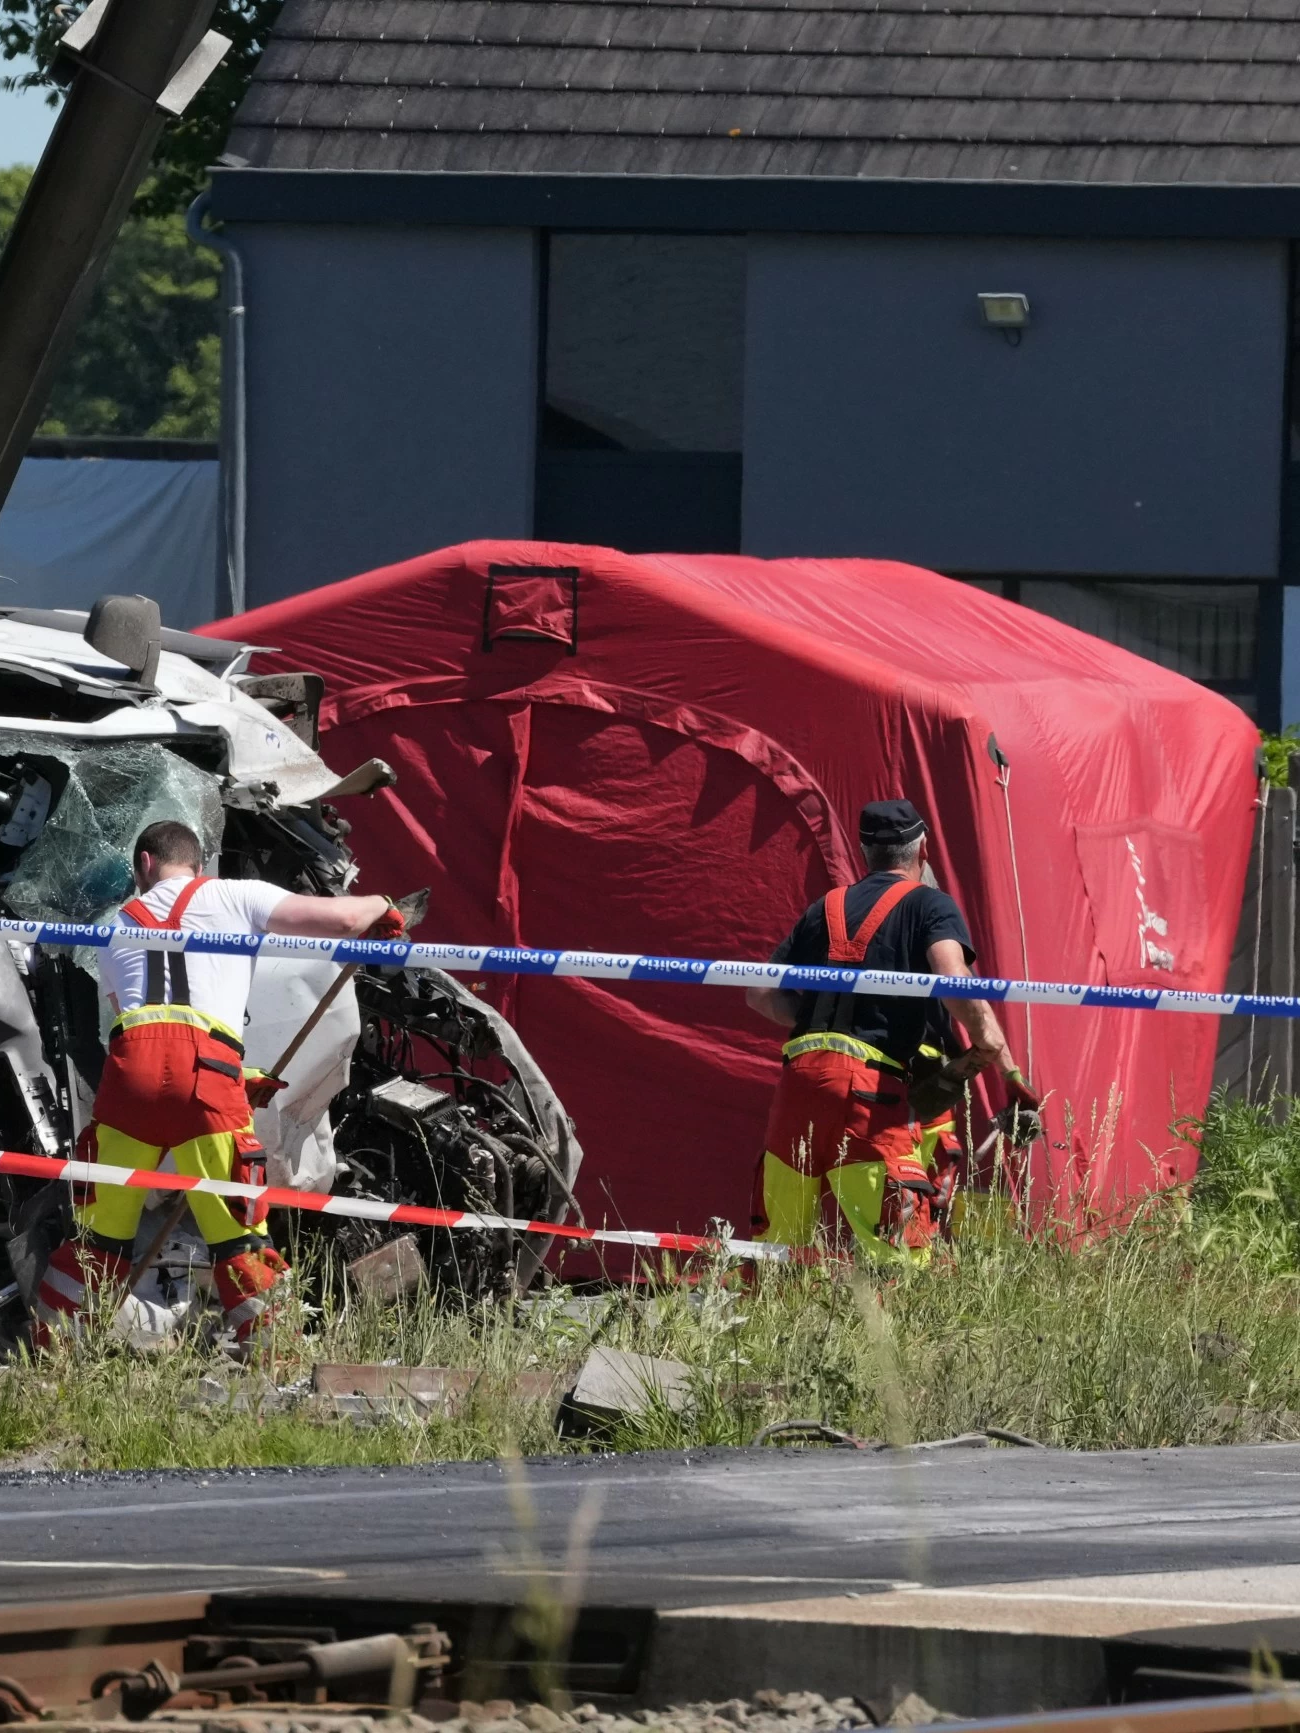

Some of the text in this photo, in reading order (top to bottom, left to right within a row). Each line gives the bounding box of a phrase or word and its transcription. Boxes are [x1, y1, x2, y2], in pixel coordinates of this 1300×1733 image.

[45, 923, 94, 937] Politie
[119, 927, 168, 940] Politie
[193, 931, 241, 945] Politie
[268, 936, 316, 950] Politie
[341, 940, 391, 955] Politie
[416, 945, 464, 959] Politie
[489, 949, 539, 963] Politie
[565, 954, 613, 968] Politie
[638, 958, 688, 972] Politie
[714, 963, 763, 976] Politie
[788, 967, 838, 981] Politie
[864, 971, 913, 985] Politie
[939, 976, 990, 990] Politie
[1016, 981, 1065, 994] Politie
[1091, 986, 1142, 999] Politie
